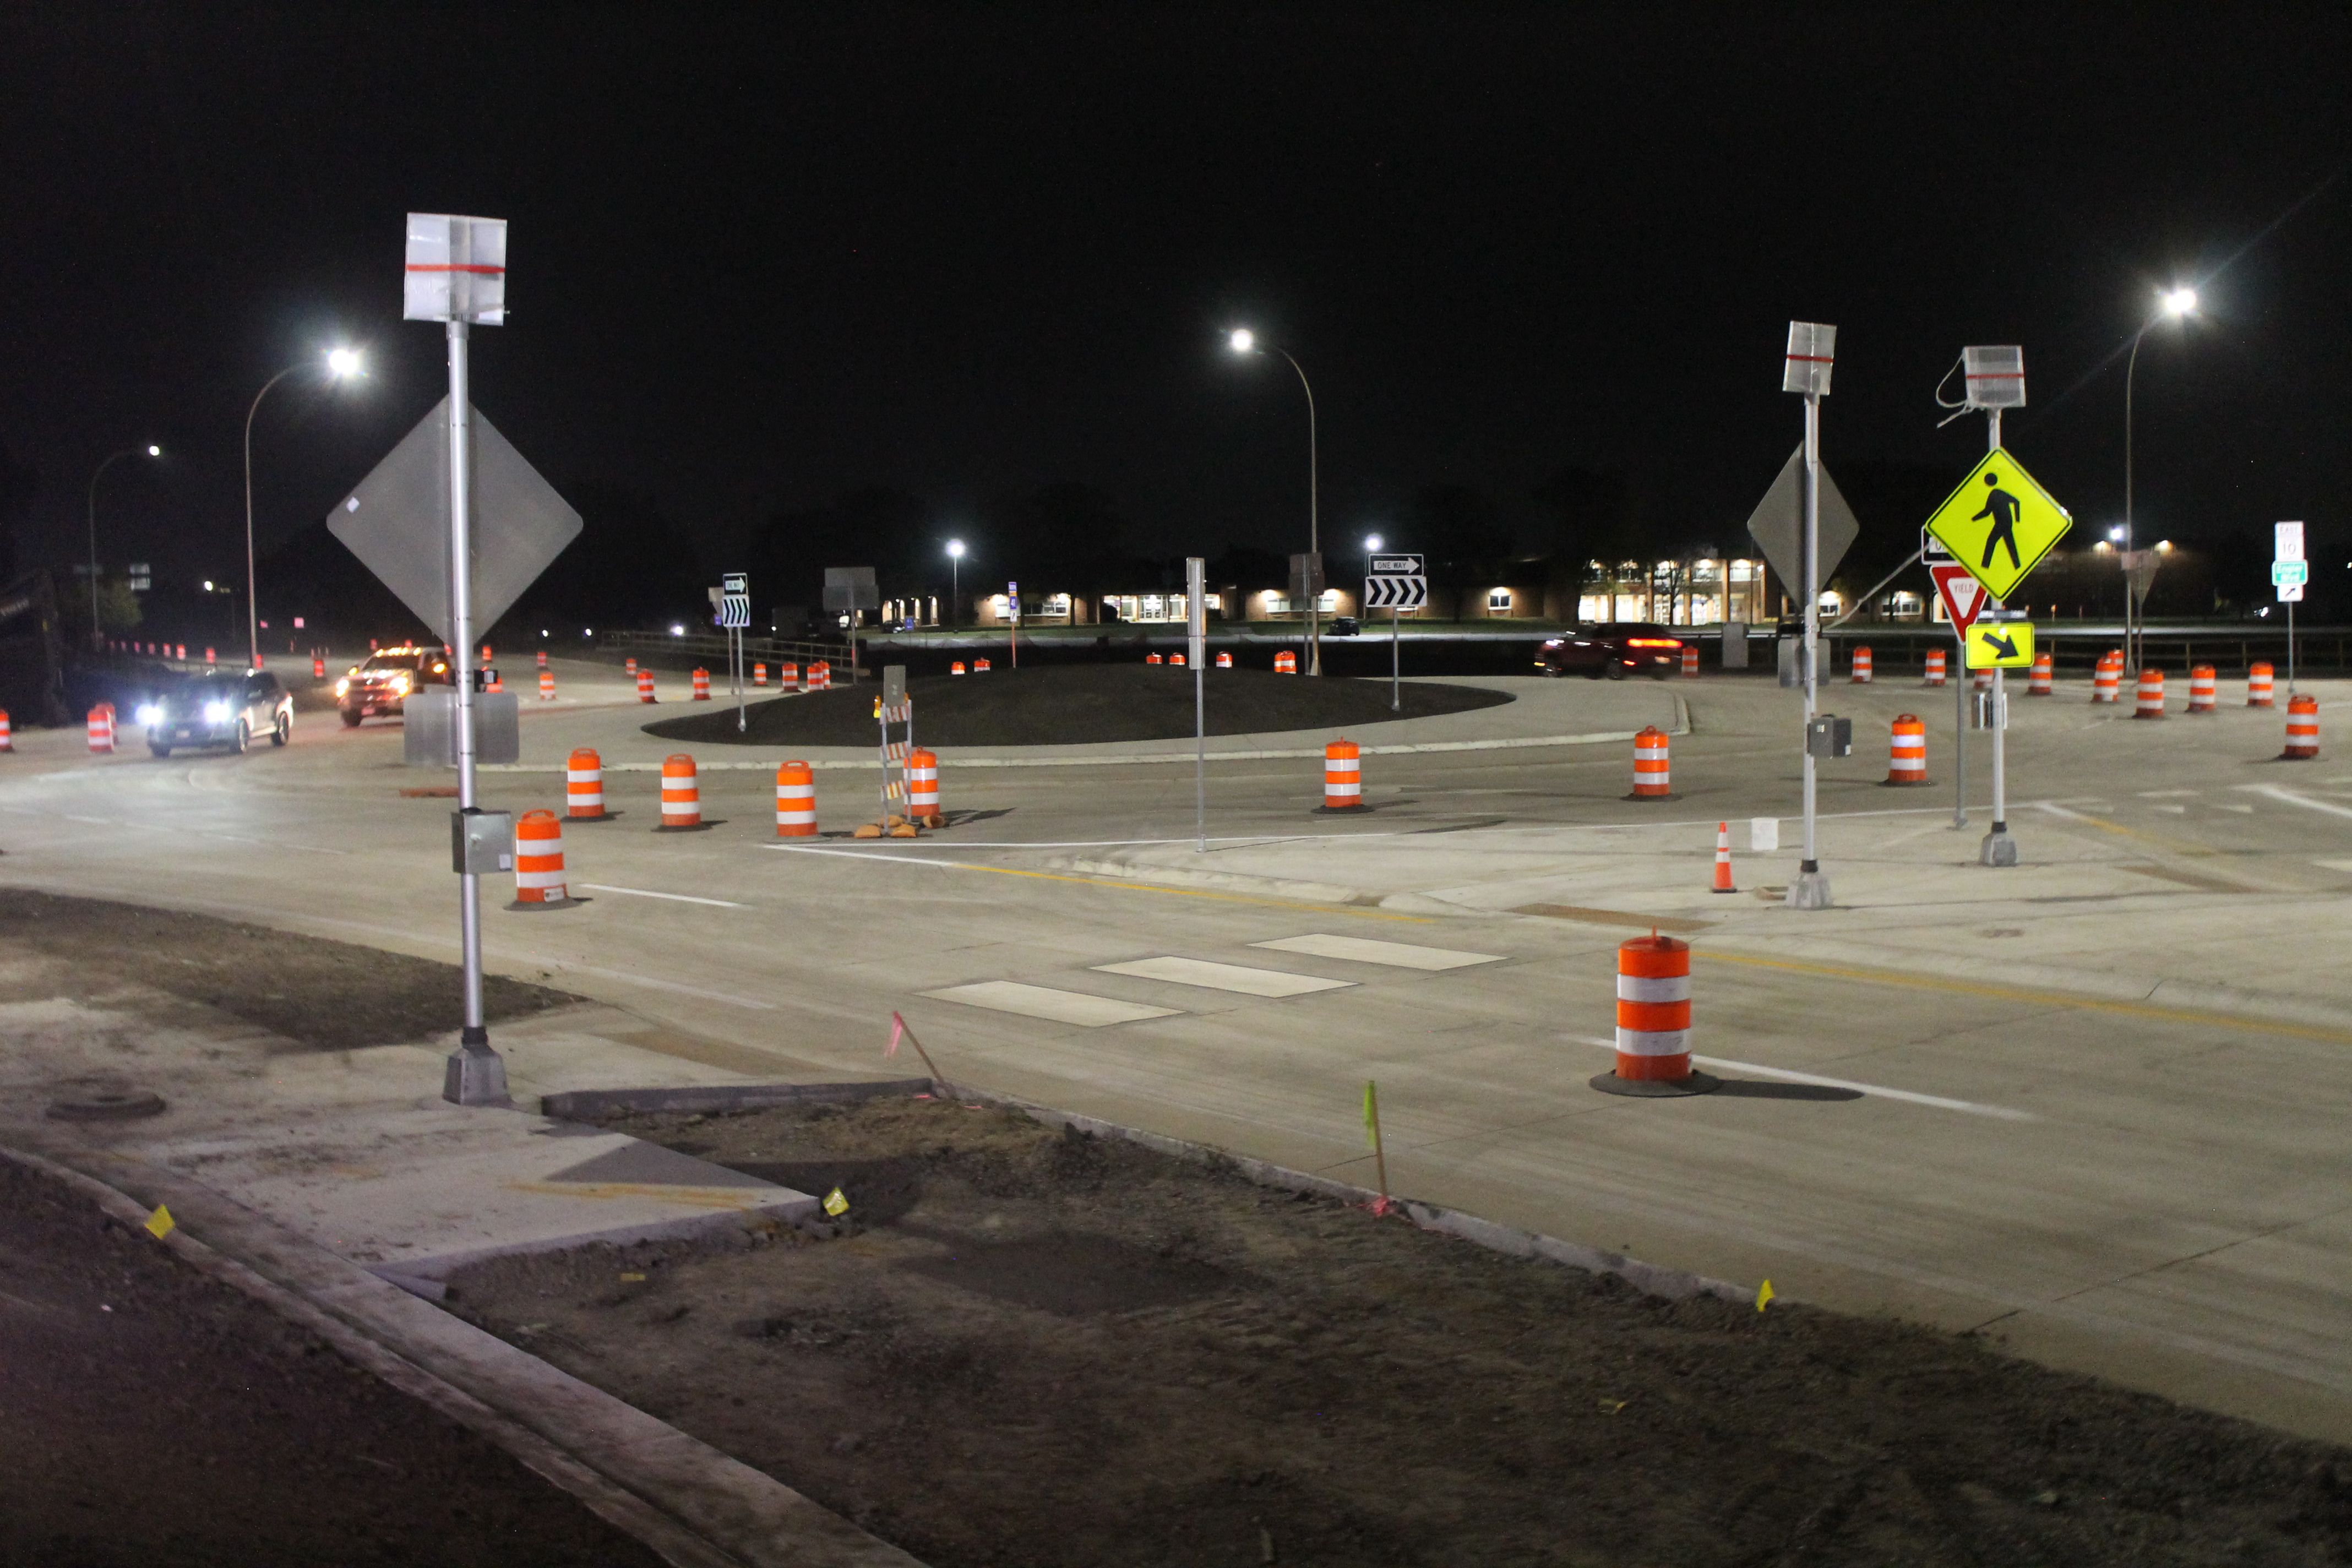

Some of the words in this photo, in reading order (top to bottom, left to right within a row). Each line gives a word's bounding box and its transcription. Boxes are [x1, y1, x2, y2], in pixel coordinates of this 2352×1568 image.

[2280, 526, 2298, 534] EAST
[2283, 543, 2296, 555] 10
[1954, 584, 1974, 593] YIELD
